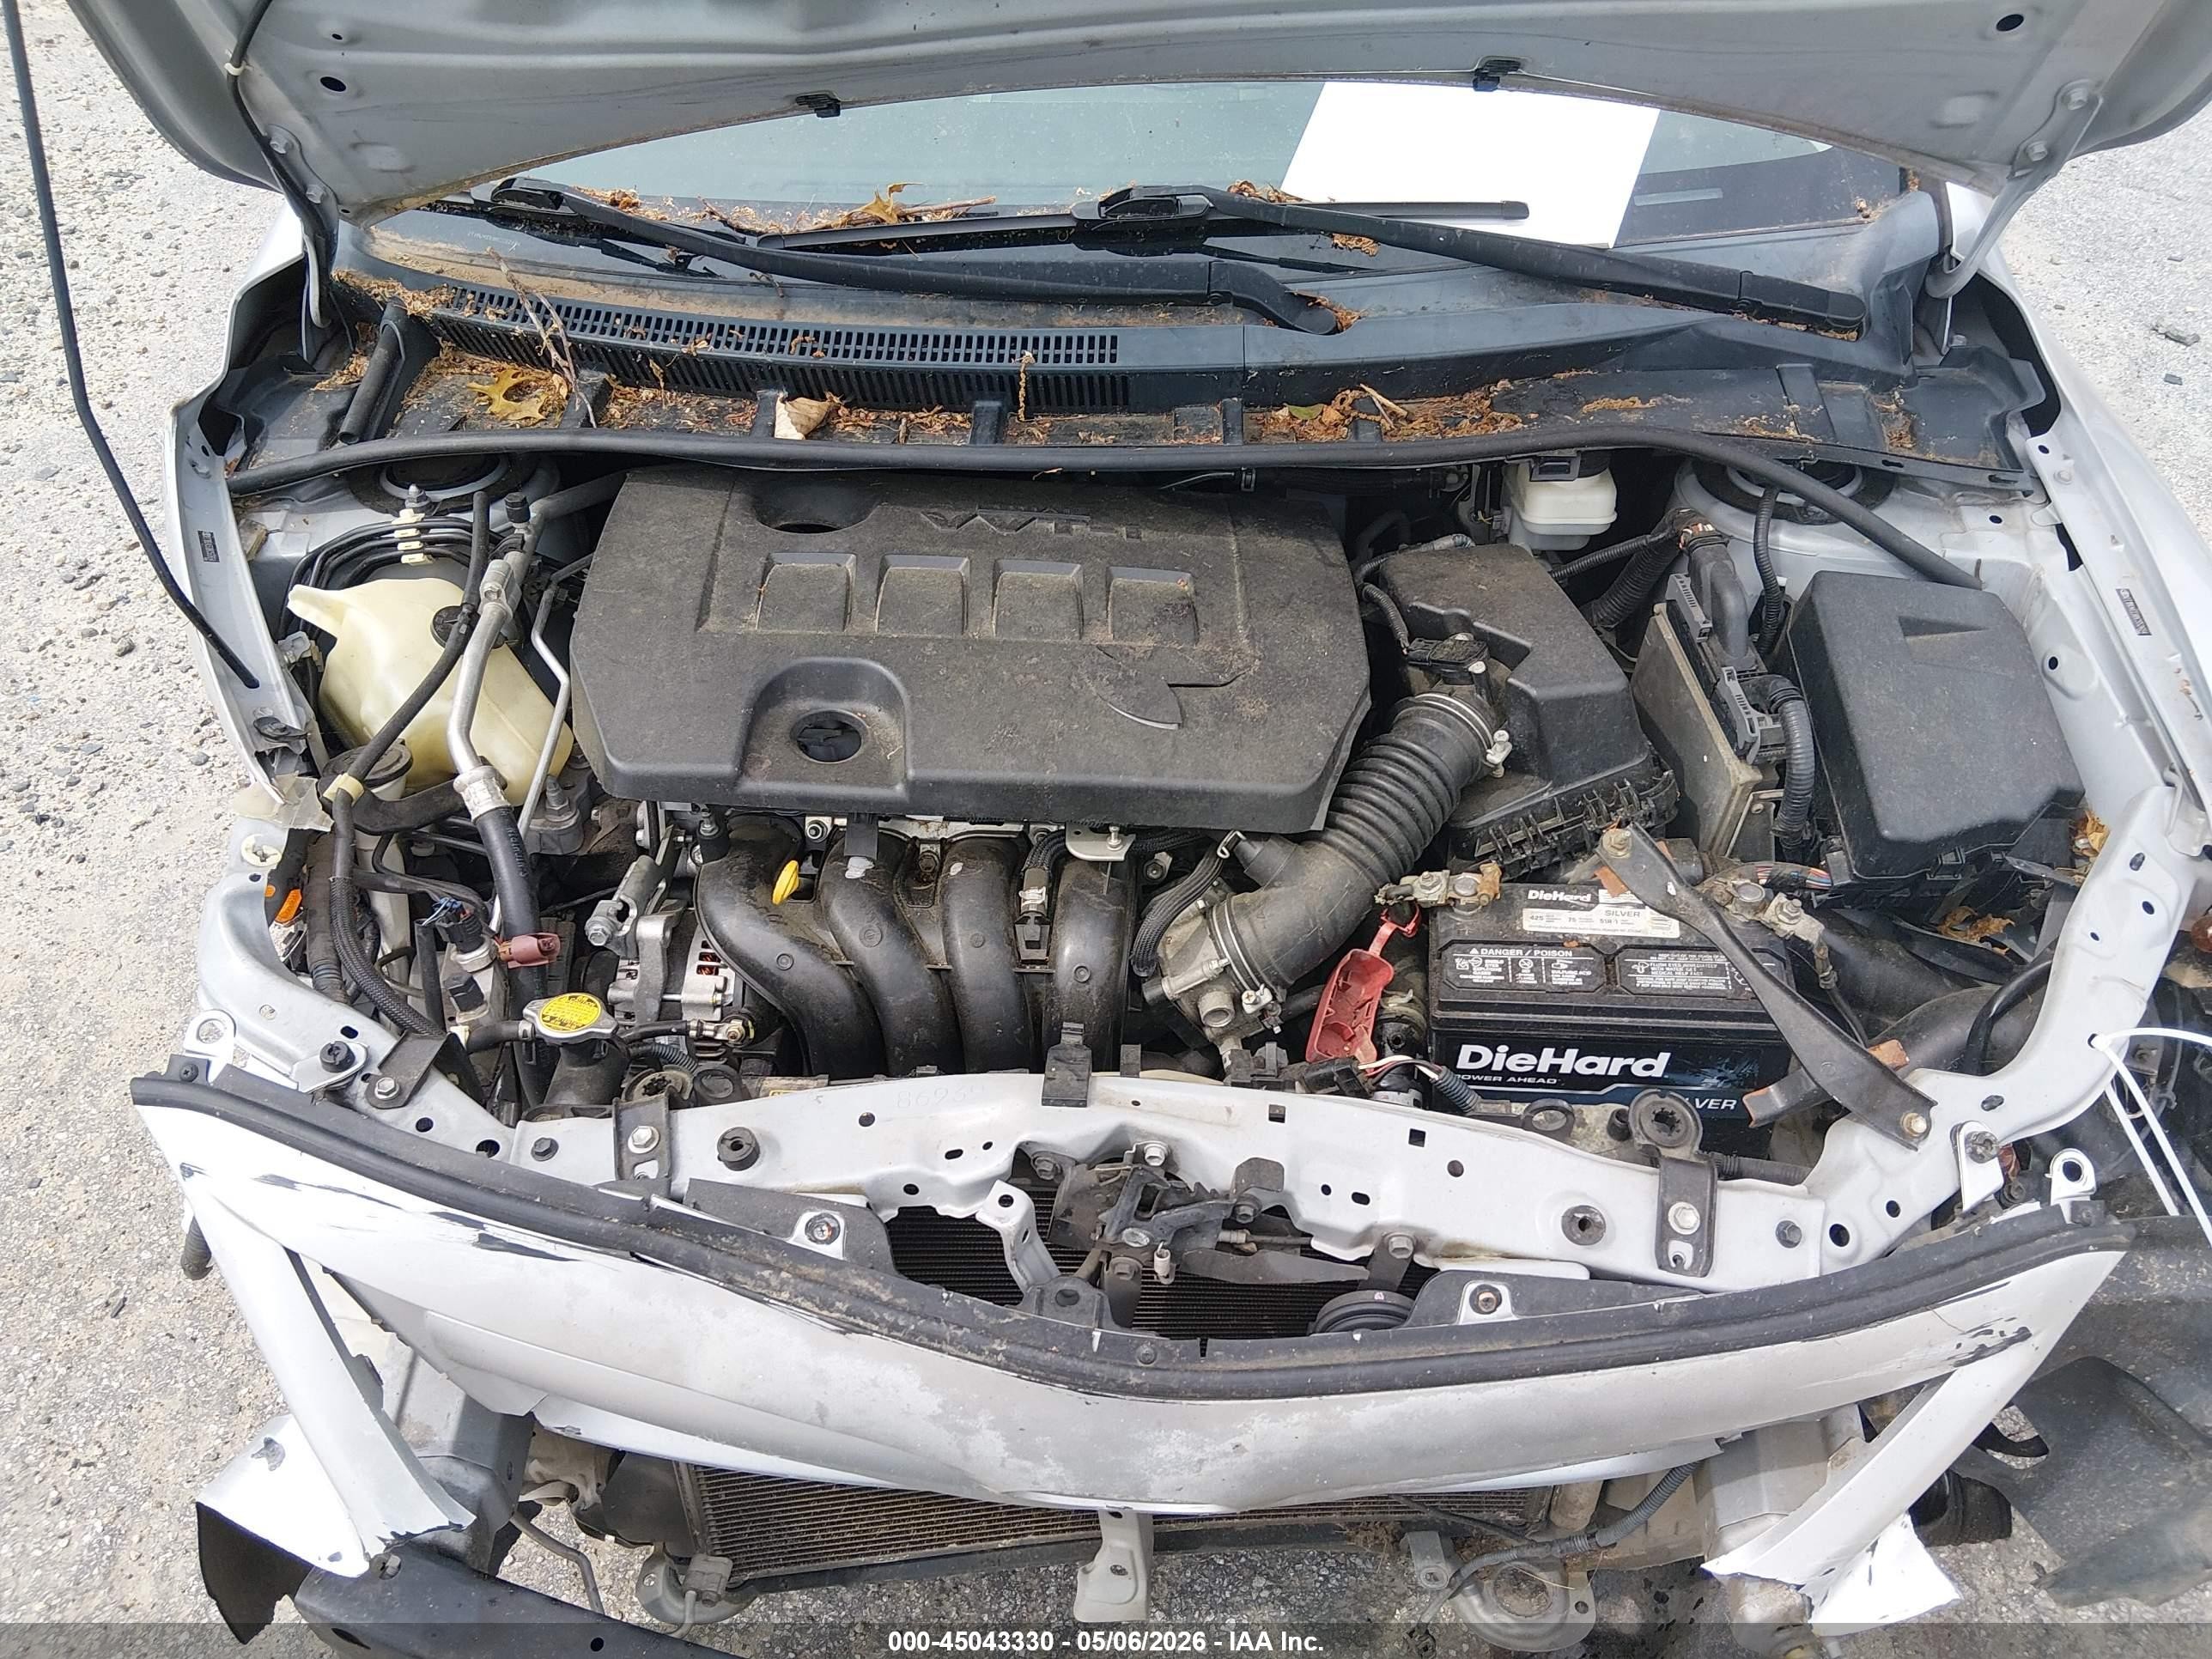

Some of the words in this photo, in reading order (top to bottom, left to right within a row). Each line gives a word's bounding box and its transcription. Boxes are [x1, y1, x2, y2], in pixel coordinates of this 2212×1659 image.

[1528, 890, 1591, 902] DieHard
[1456, 1044, 1671, 1078] DieHard
[1694, 1097, 1737, 1110] VER
